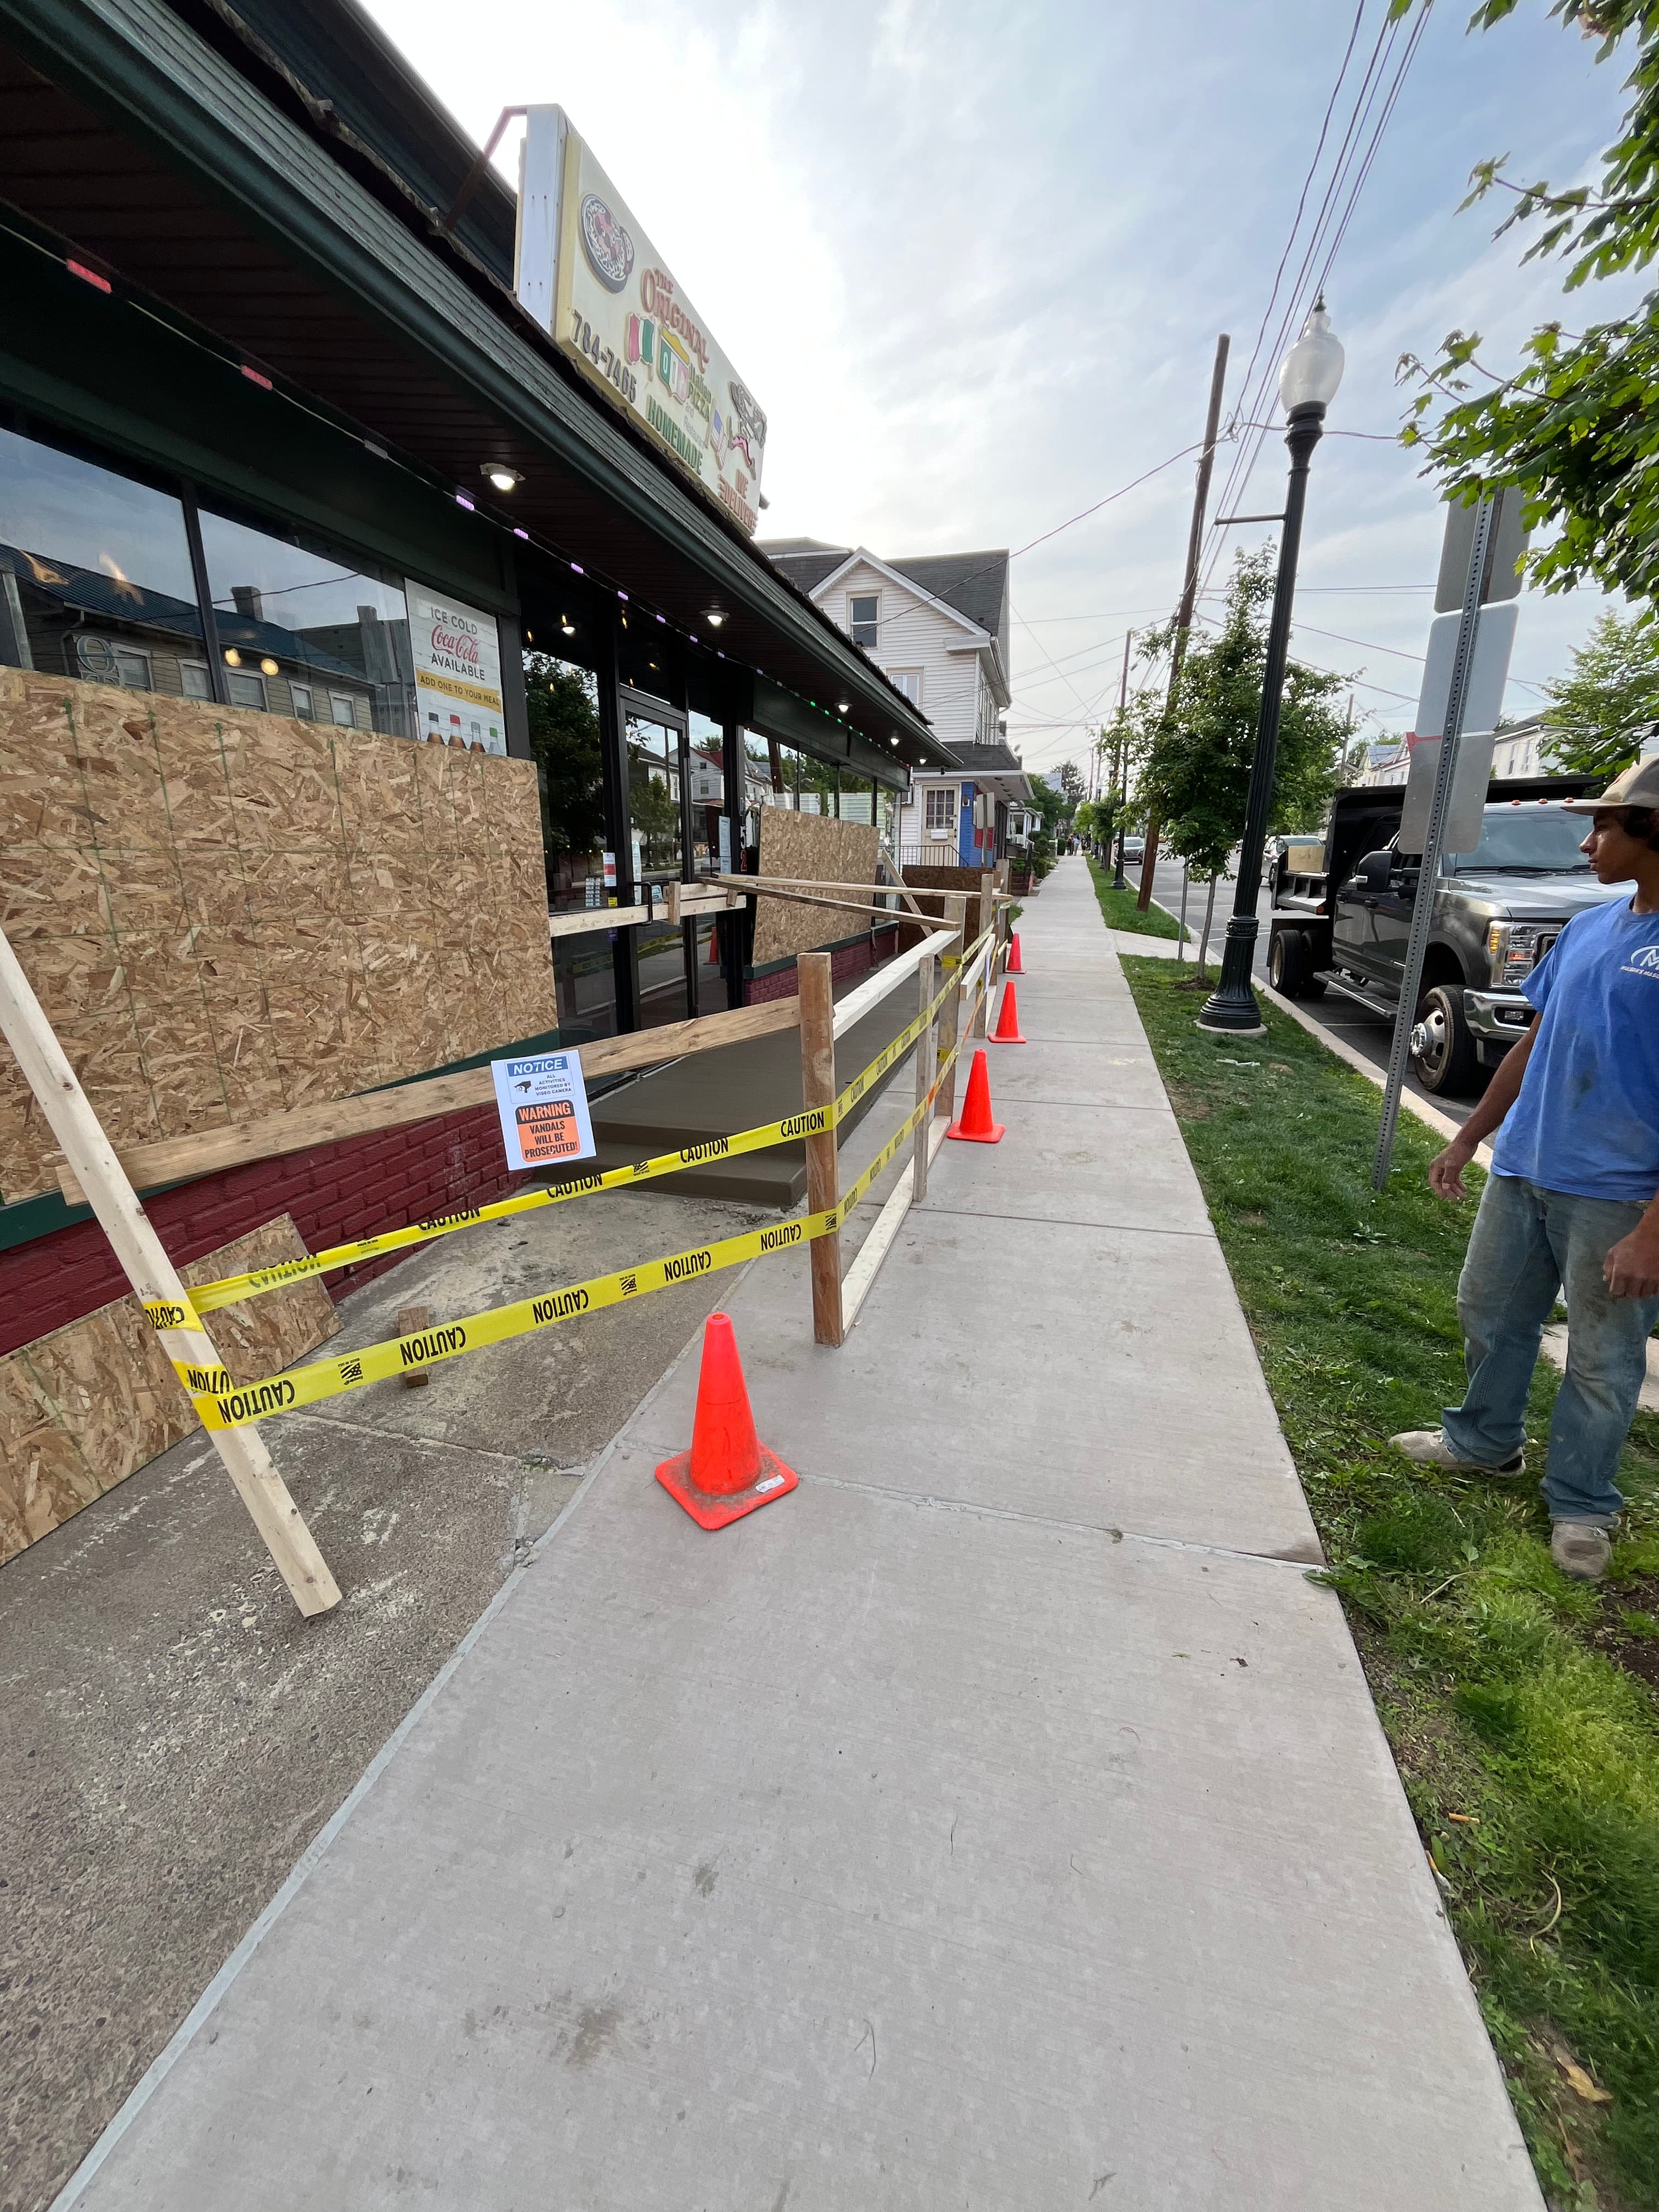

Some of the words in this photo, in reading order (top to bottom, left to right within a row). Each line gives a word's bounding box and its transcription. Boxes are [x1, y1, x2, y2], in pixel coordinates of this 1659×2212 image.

[573, 308, 637, 403] 784-7465
[689, 363, 712, 404] Italian
[687, 382, 709, 422] PIZZA
[647, 394, 703, 476] HOMEMADE
[736, 470, 748, 499] WE
[723, 481, 754, 532] DELIVER
[431, 606, 448, 624] ICE
[451, 615, 477, 635] COLD
[431, 652, 486, 681] AVAILABLE
[420, 675, 436, 686] ADD
[437, 680, 453, 692] ONE
[454, 685, 463, 695] TO
[465, 687, 482, 701] YOUR
[483, 693, 500, 707] MEAL
[514, 1058, 563, 1075] NOTICE
[535, 1083, 563, 1091] MONITORED
[518, 1102, 571, 1121] WARNING
[780, 1110, 825, 1138] CAUTION
[529, 1120, 566, 1135] VANDALS
[534, 1133, 553, 1146] WILL
[554, 1132, 565, 1142] BE
[524, 1141, 578, 1159] PROSECUTED!
[680, 1137, 729, 1164] CAUTION
[546, 1173, 603, 1199] CAUTION
[760, 1223, 802, 1251] CAUTION
[664, 1250, 712, 1282] CAUTION
[533, 1288, 589, 1324] CAUTION
[399, 1325, 467, 1367] CAUTION
[187, 1369, 230, 1395] UTION
[217, 1379, 296, 1424] CAUTION
